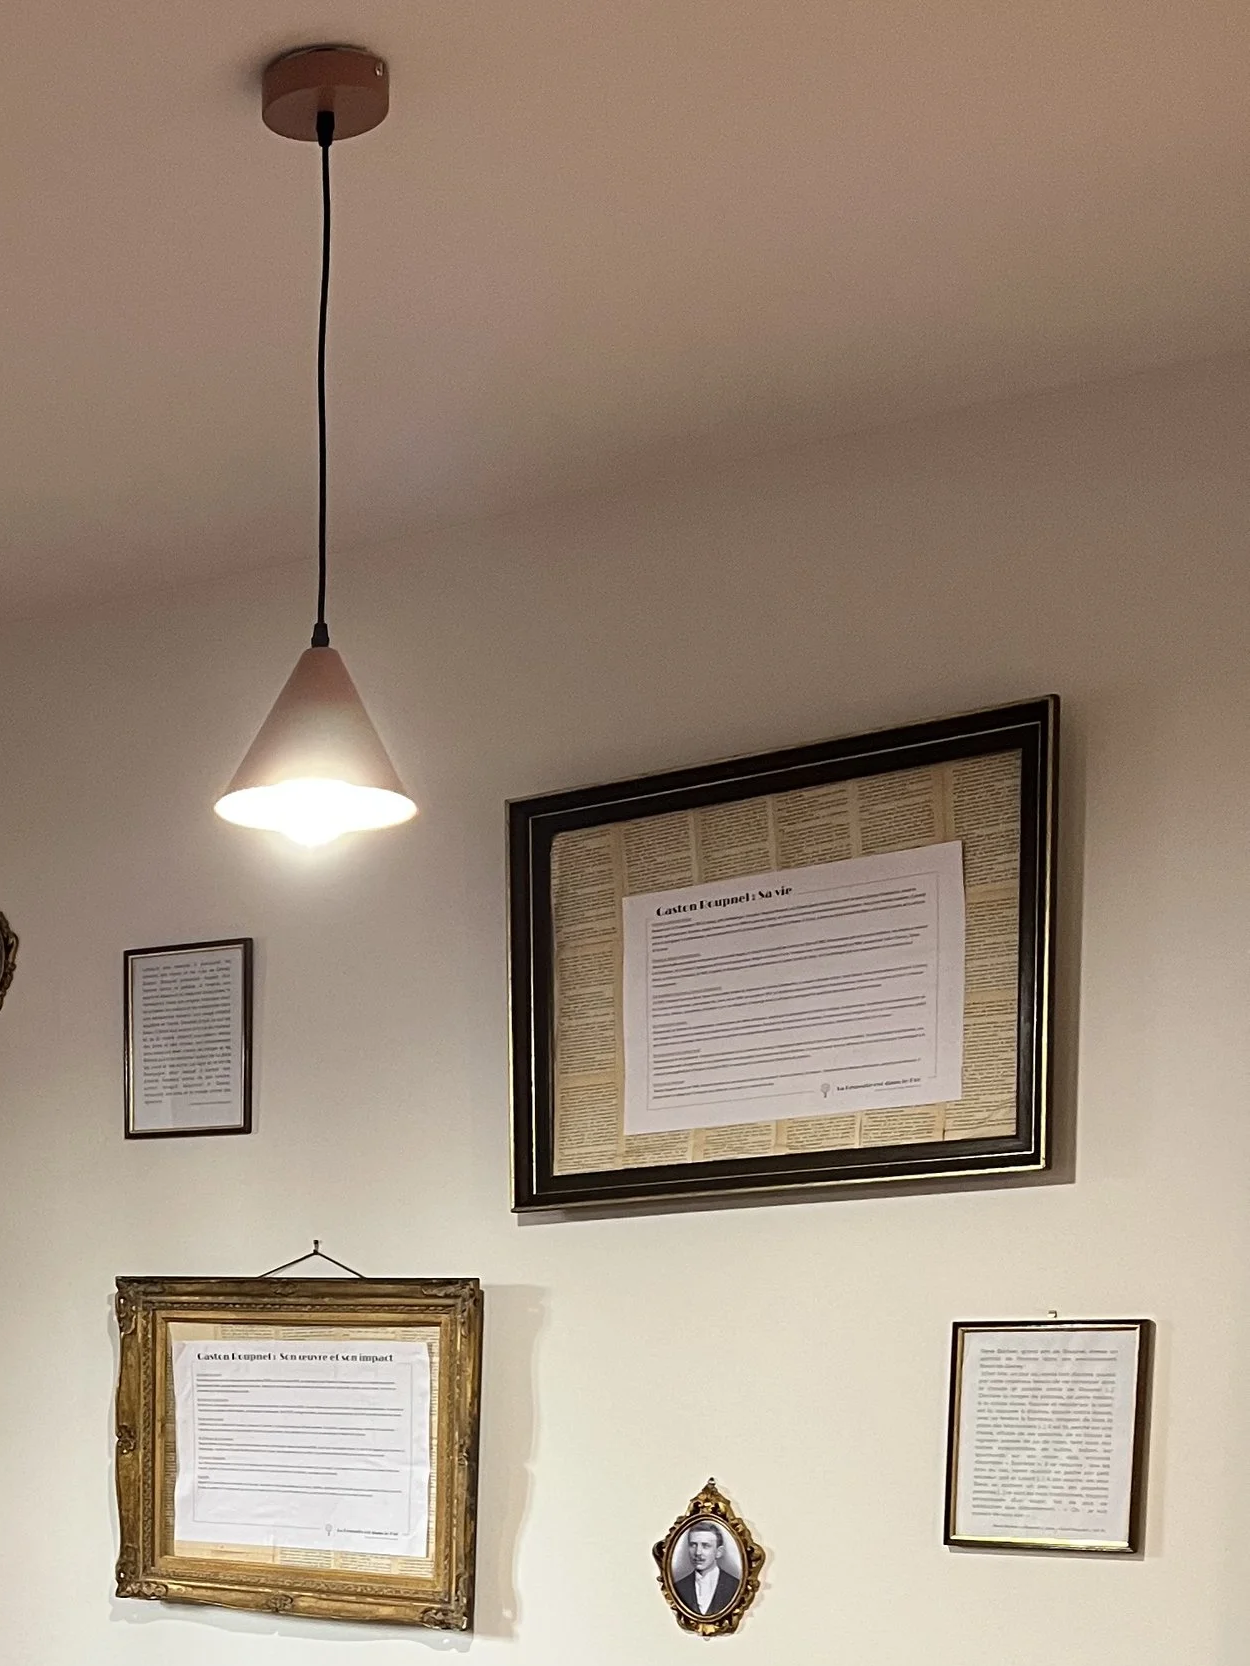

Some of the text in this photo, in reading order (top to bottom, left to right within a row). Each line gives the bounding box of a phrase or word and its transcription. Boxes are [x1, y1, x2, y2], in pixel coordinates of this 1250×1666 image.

[656, 903, 697, 917] Gaston
[700, 892, 750, 909] Roupnel
[758, 890, 772, 899] Sa
[775, 885, 792, 896] vie
[197, 1353, 230, 1361] Gaston
[279, 1353, 297, 1361] Son
[329, 1353, 339, 1362] et
[341, 1354, 357, 1362] son
[359, 1354, 394, 1364] impact
